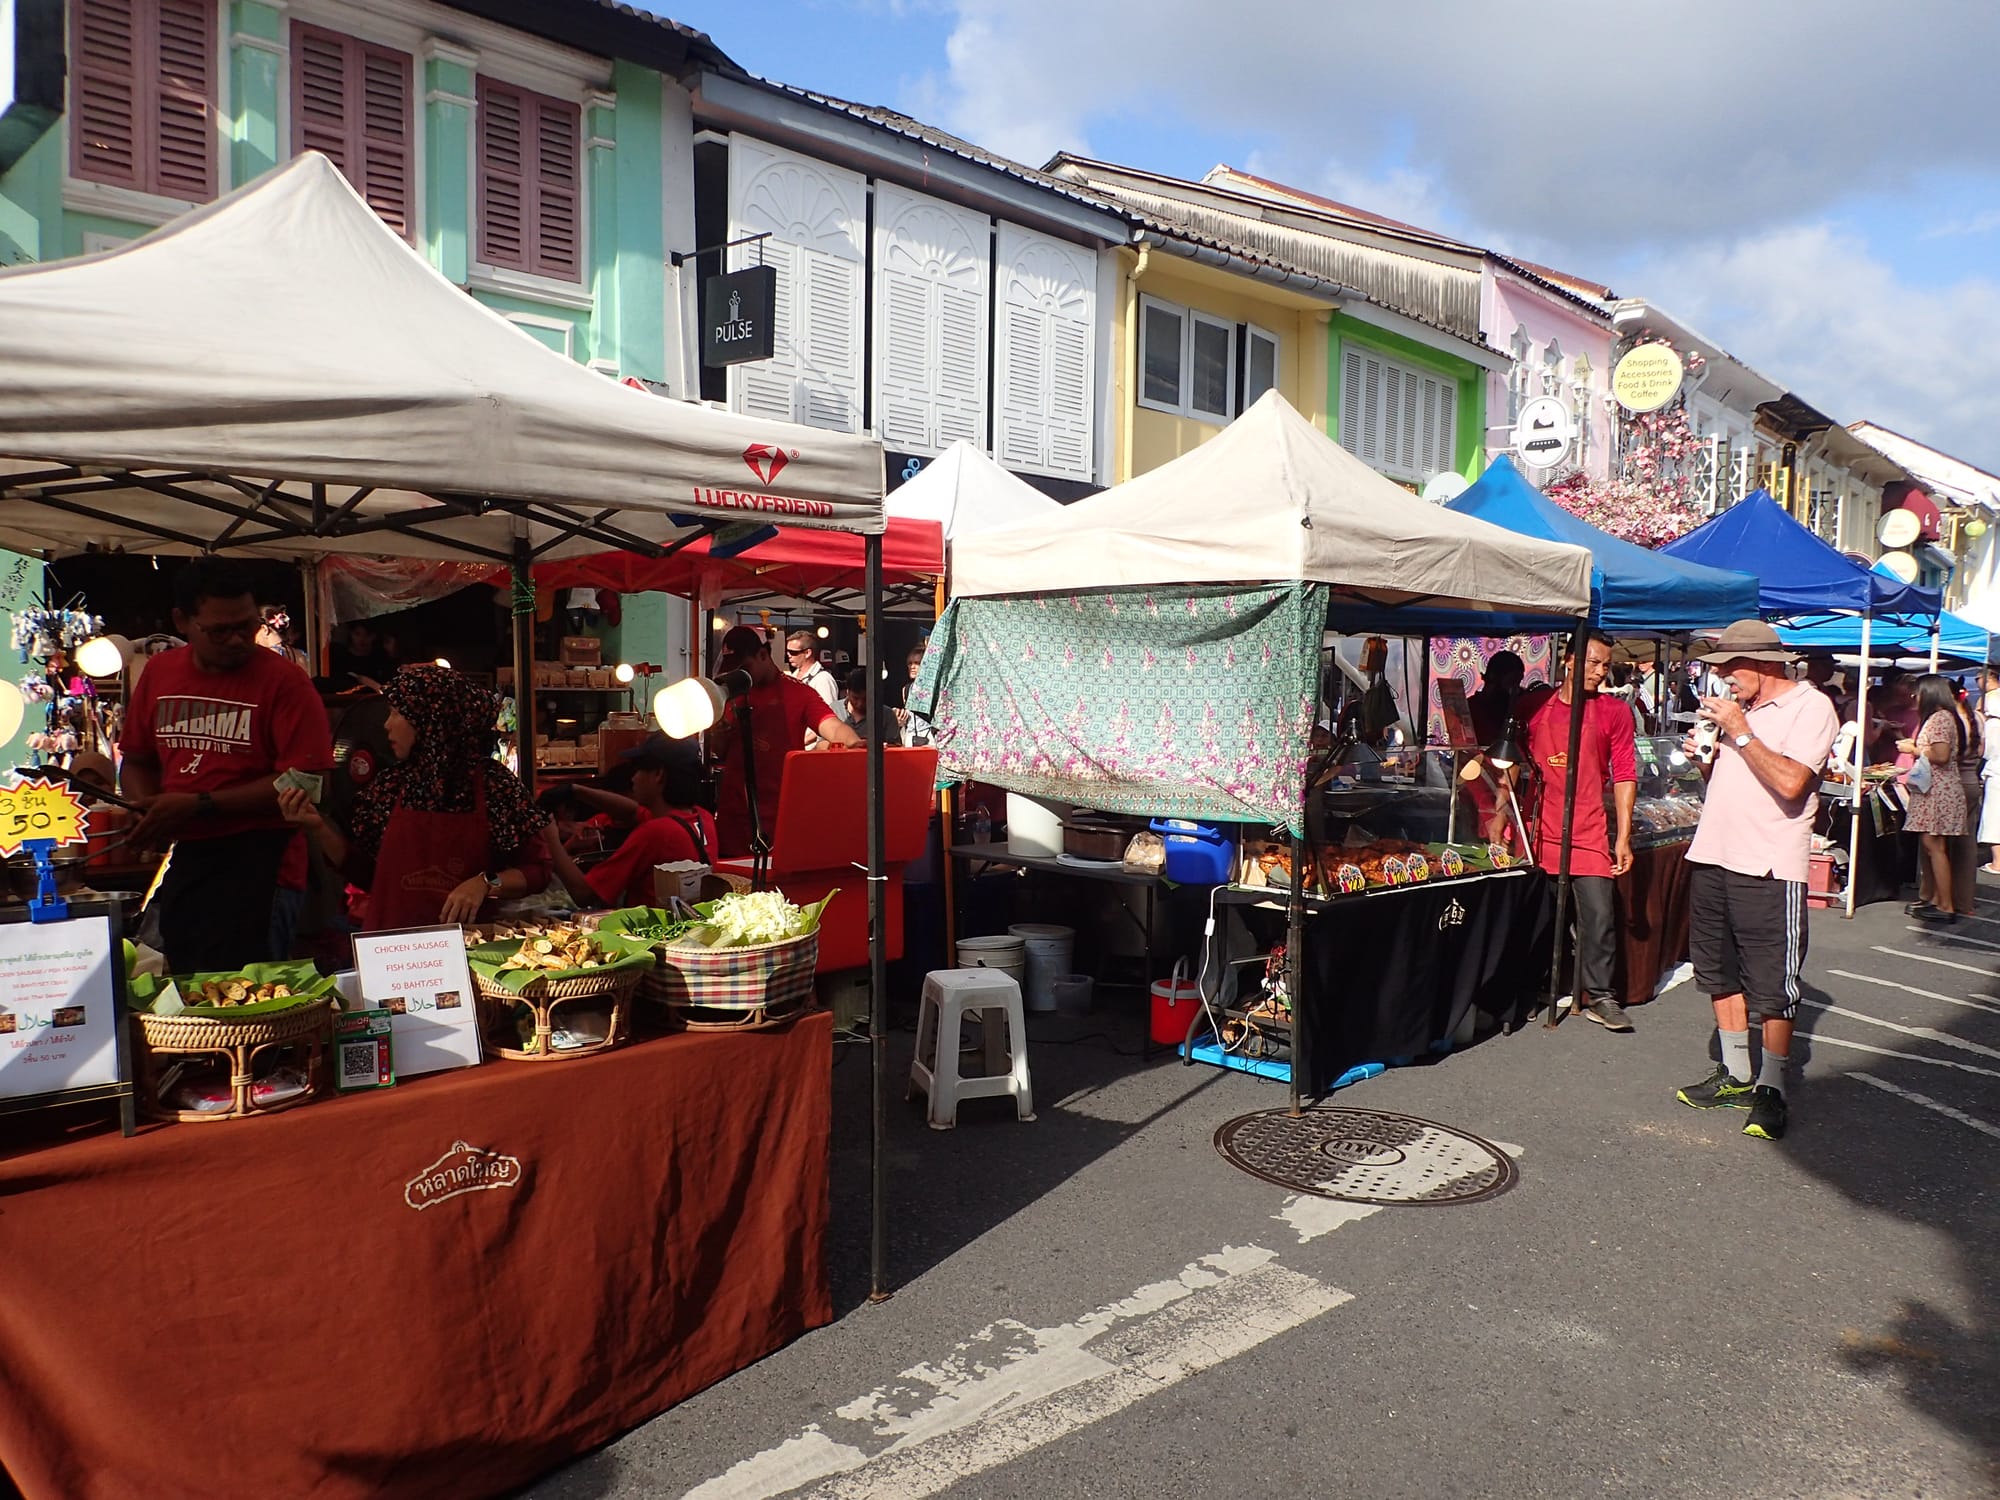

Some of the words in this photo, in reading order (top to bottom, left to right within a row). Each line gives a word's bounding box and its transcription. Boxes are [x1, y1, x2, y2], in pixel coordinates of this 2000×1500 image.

[715, 321, 753, 344] PULSE
[1626, 358, 1669, 368] Shopping
[1620, 369, 1673, 379] Accessories
[1618, 381, 1639, 390] Food
[1649, 378, 1673, 388] Drink
[1630, 390, 1659, 399] Coffee
[693, 487, 834, 518] LUCKYFRIEND
[156, 701, 252, 741] ALABAMA
[180, 753, 203, 775] A
[374, 944, 410, 954] CHICKEN
[412, 940, 449, 951] SAUSAGE
[385, 963, 404, 972] FISH
[406, 959, 445, 970] SAUSAGE
[391, 982, 401, 991] 50
[404, 978, 444, 990] BAHT/SET
[407, 997, 436, 1013] حلال
[18, 1013, 52, 1031] حلال
[415, 1155, 510, 1197] หลาดใหญ่
